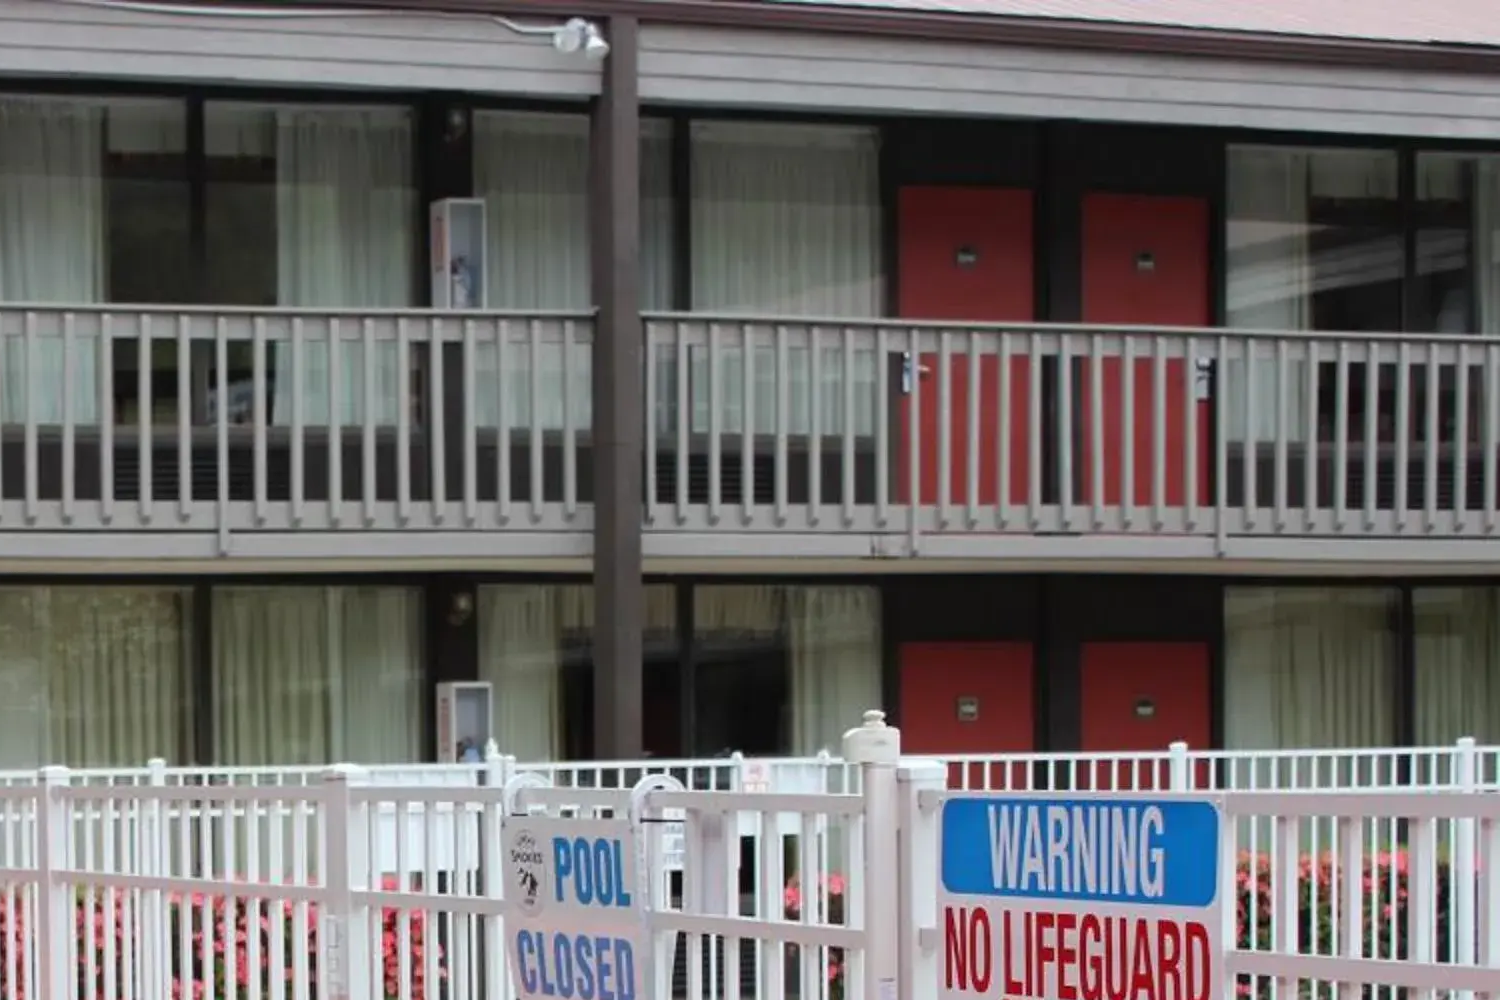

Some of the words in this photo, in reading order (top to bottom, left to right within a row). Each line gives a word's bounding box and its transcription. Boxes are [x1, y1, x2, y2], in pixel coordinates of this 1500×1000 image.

[553, 836, 631, 907] POOL
[988, 804, 1165, 898] WARNING
[945, 907, 991, 993] NO
